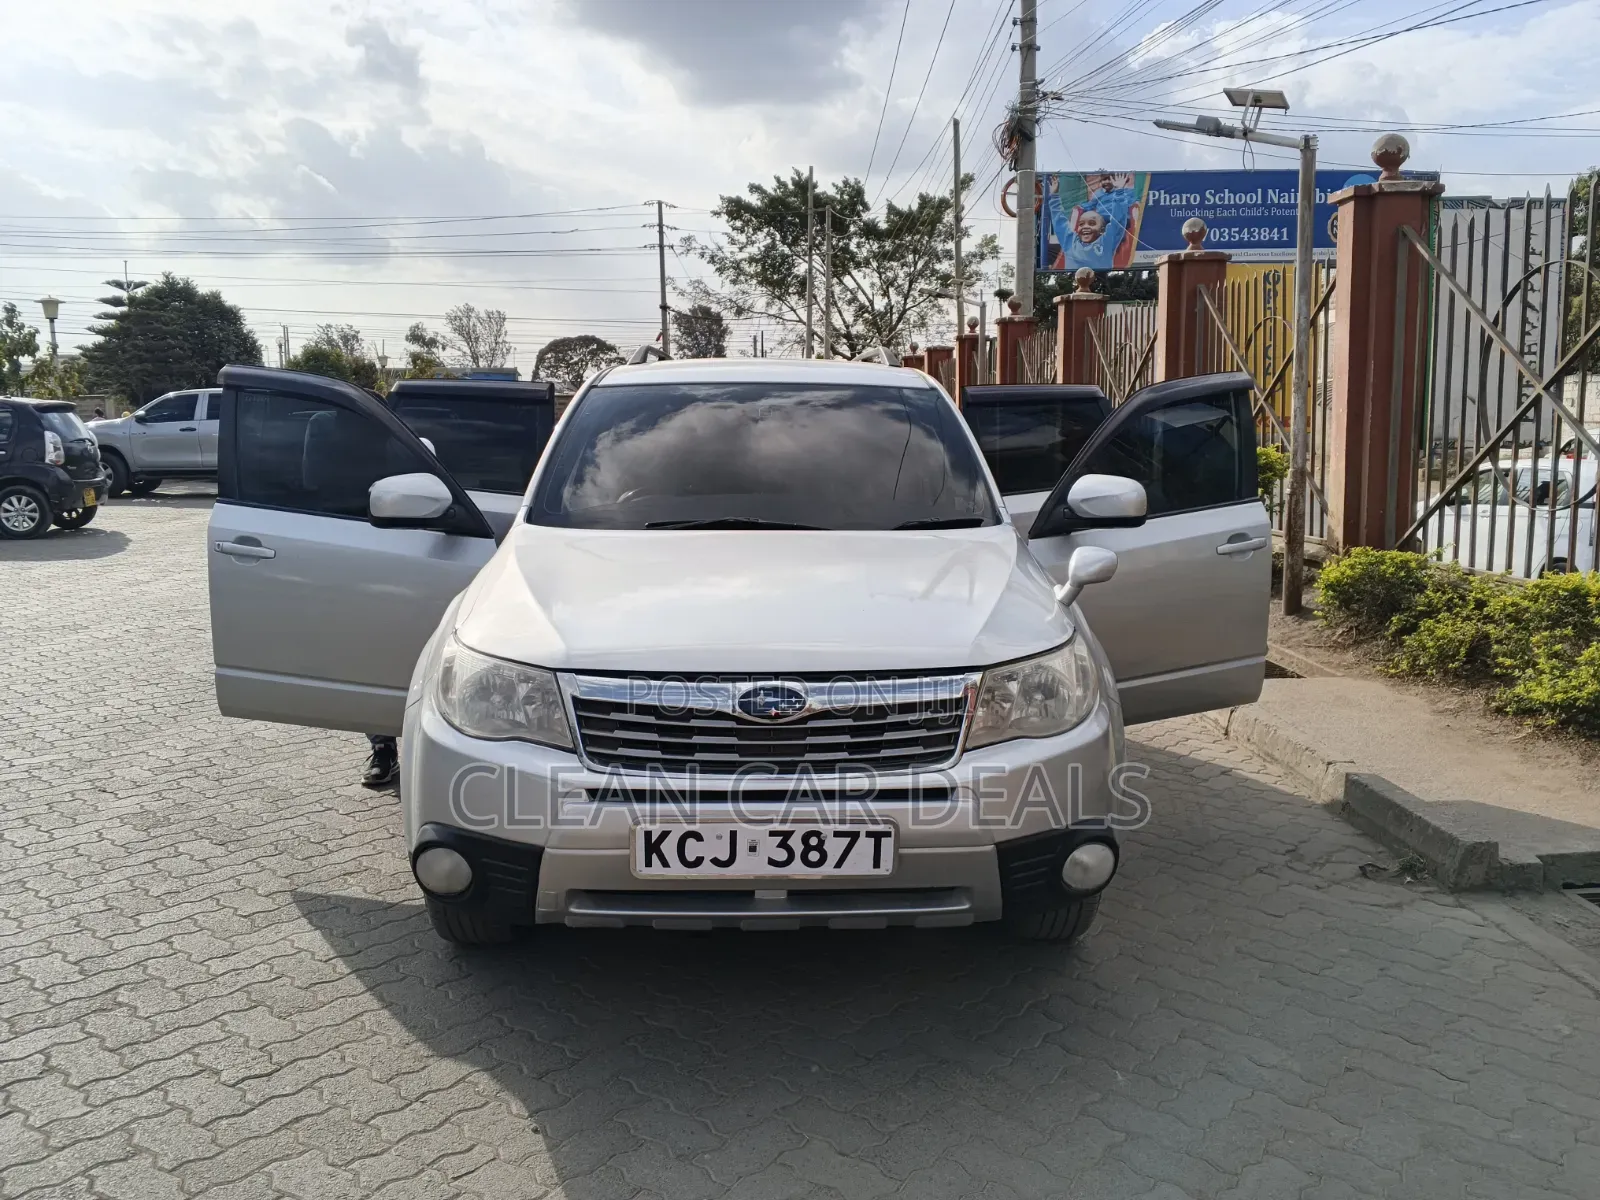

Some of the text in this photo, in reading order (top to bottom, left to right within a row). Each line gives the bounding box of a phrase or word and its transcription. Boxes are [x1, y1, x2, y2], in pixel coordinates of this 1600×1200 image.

[1147, 189, 1201, 206] Pharo
[1204, 188, 1262, 205] School
[1170, 207, 1215, 218] Unlocking
[1216, 207, 1238, 217] Each
[1239, 206, 1269, 216] Child's
[643, 829, 738, 869] KCJ
[767, 829, 893, 870] 387T
